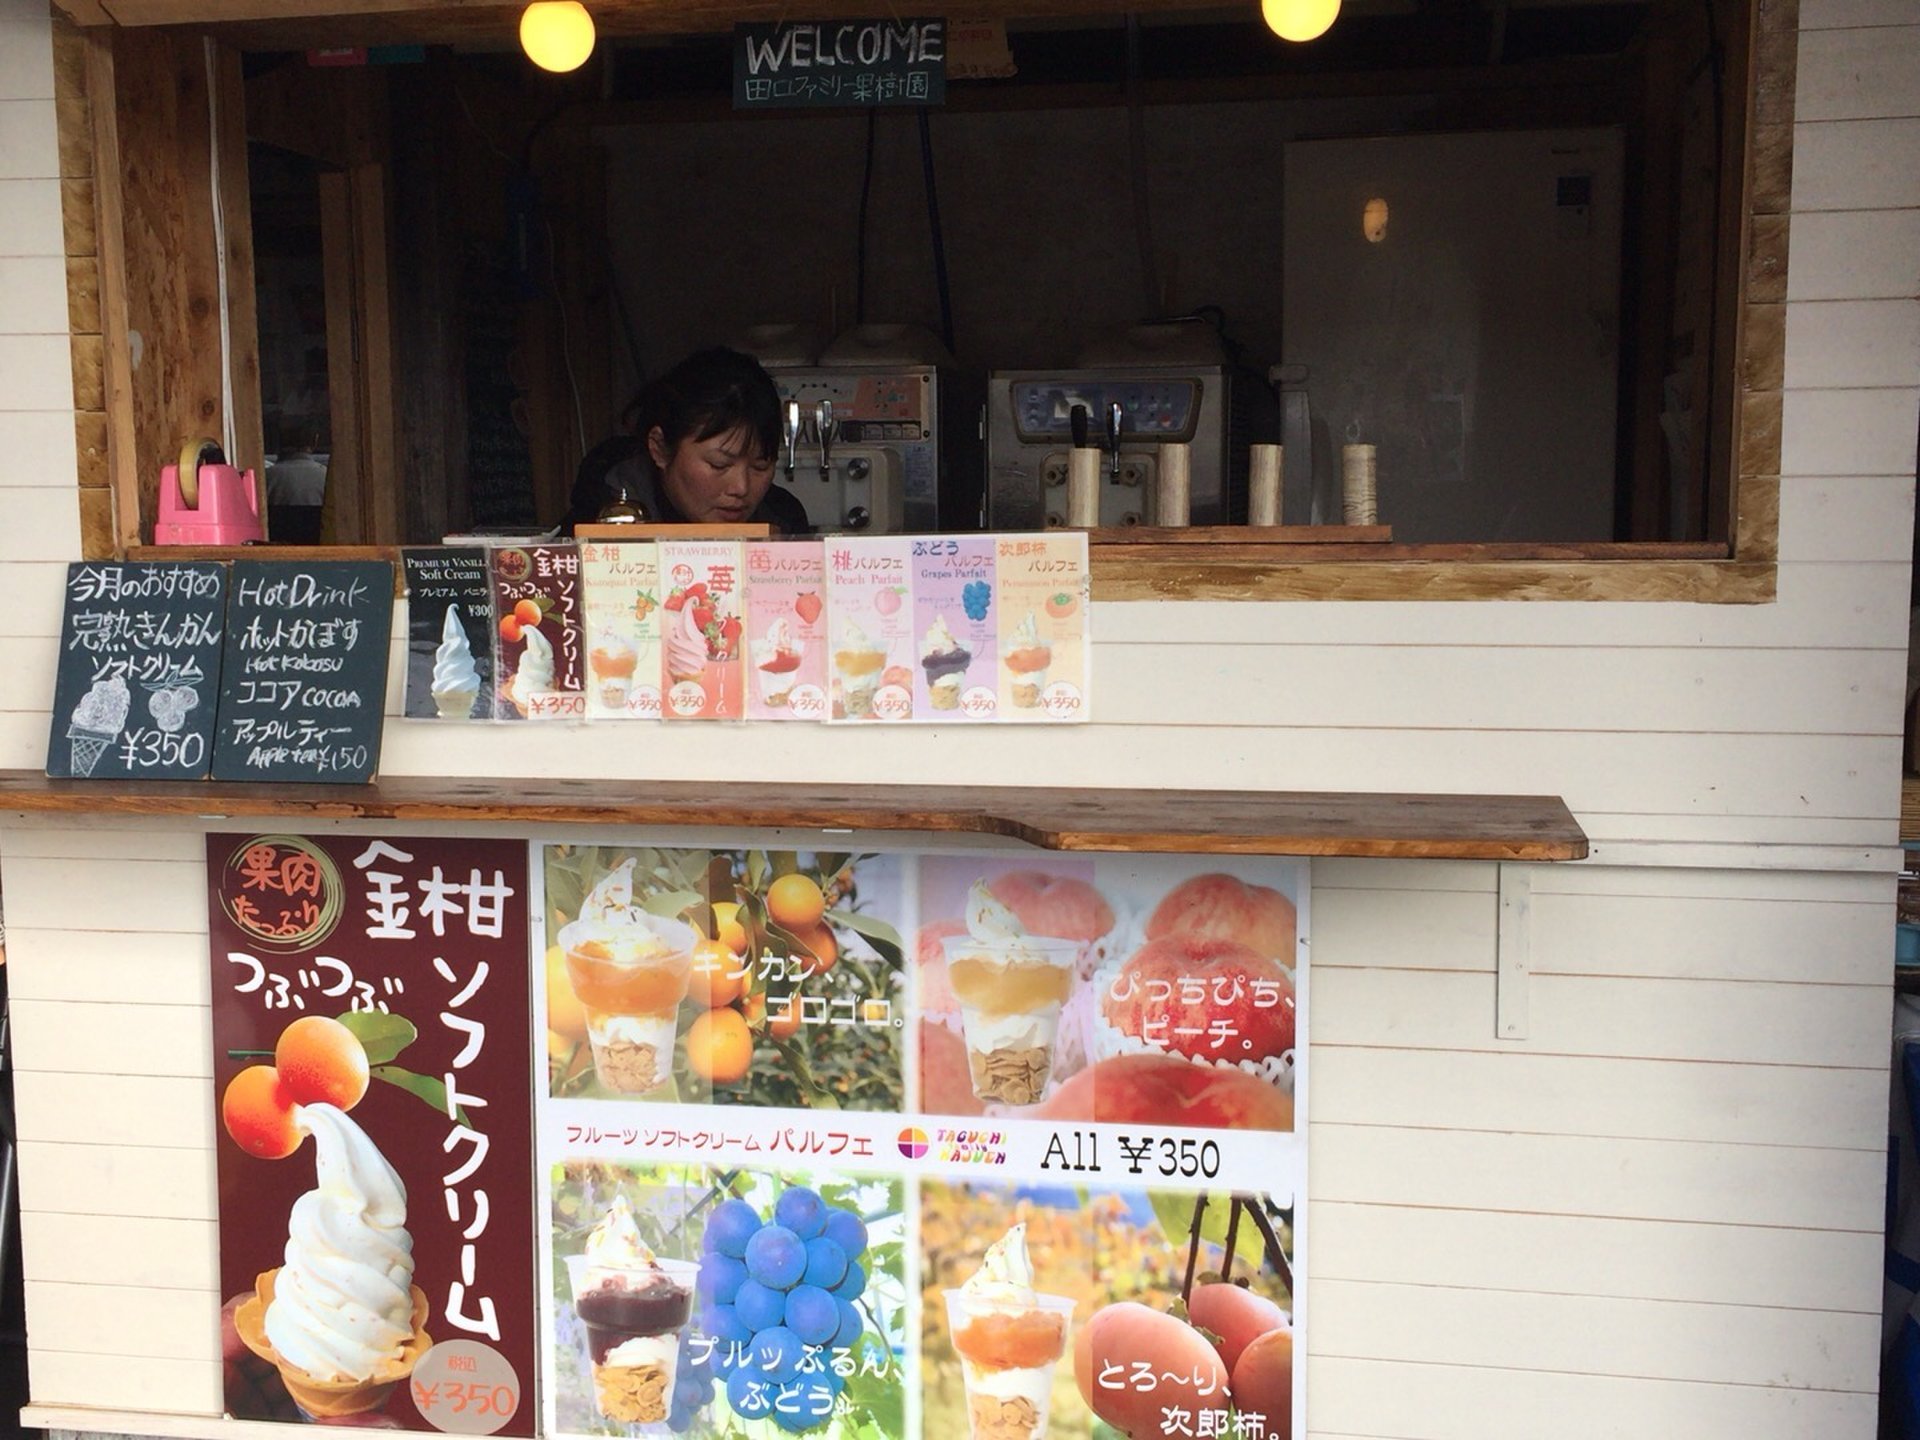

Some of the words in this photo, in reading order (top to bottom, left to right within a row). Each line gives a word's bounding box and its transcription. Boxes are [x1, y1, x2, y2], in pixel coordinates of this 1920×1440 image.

[746, 23, 943, 75] WELCOME
[745, 71, 929, 101] 田口ファミリー果樹園
[406, 557, 450, 569] PREMIUM
[533, 548, 579, 577] 金柑
[584, 545, 620, 563] 金柑
[664, 546, 733, 557] STRAWBERRY
[912, 541, 959, 556] ぶどう
[1000, 542, 1047, 557] 次郎柿
[68, 564, 221, 602] 今月のおすすめ
[419, 568, 442, 580] Soft
[444, 568, 481, 580] Cream
[835, 575, 865, 585] Peach
[871, 575, 904, 585] Parfait
[921, 569, 952, 580] Grapes
[955, 569, 987, 579] Parfait
[238, 577, 288, 607] Hot
[289, 574, 370, 608] Drink
[419, 587, 458, 598] プレミアム
[499, 582, 551, 599] つぶつぶ
[468, 604, 494, 618] ¥300
[69, 608, 222, 652] 完熟きんかん
[240, 615, 362, 652] ホットかぼす
[557, 580, 581, 690] ソフトクリーム
[91, 652, 204, 683] ソフトクリーム
[245, 655, 280, 674] Hot
[237, 681, 302, 710] ココア
[531, 696, 585, 715] ¥350
[118, 726, 204, 770] ¥350
[233, 719, 352, 746] アップルティー
[241, 845, 321, 897] 果肉
[352, 840, 514, 939] 金柑
[235, 894, 319, 938] たっぷり
[692, 947, 834, 984] キンカン、
[227, 952, 404, 1015] つぶつぶ
[1109, 971, 1295, 1009] ぴっちぴち、
[767, 993, 904, 1028] ゴロゴロ。
[1142, 1015, 1253, 1050] ピーチ。
[433, 956, 501, 1341] ソフトクリーム
[567, 1126, 638, 1145] フルーツ
[645, 1128, 761, 1151] ソフトクリーム
[769, 1128, 874, 1156] パルフェ
[937, 1129, 1007, 1145] TAGUCHI
[1040, 1131, 1101, 1172] All
[1118, 1135, 1221, 1179] ¥350
[414, 1379, 515, 1418] ¥350
[1160, 1405, 1279, 1440] 次郎柿。
